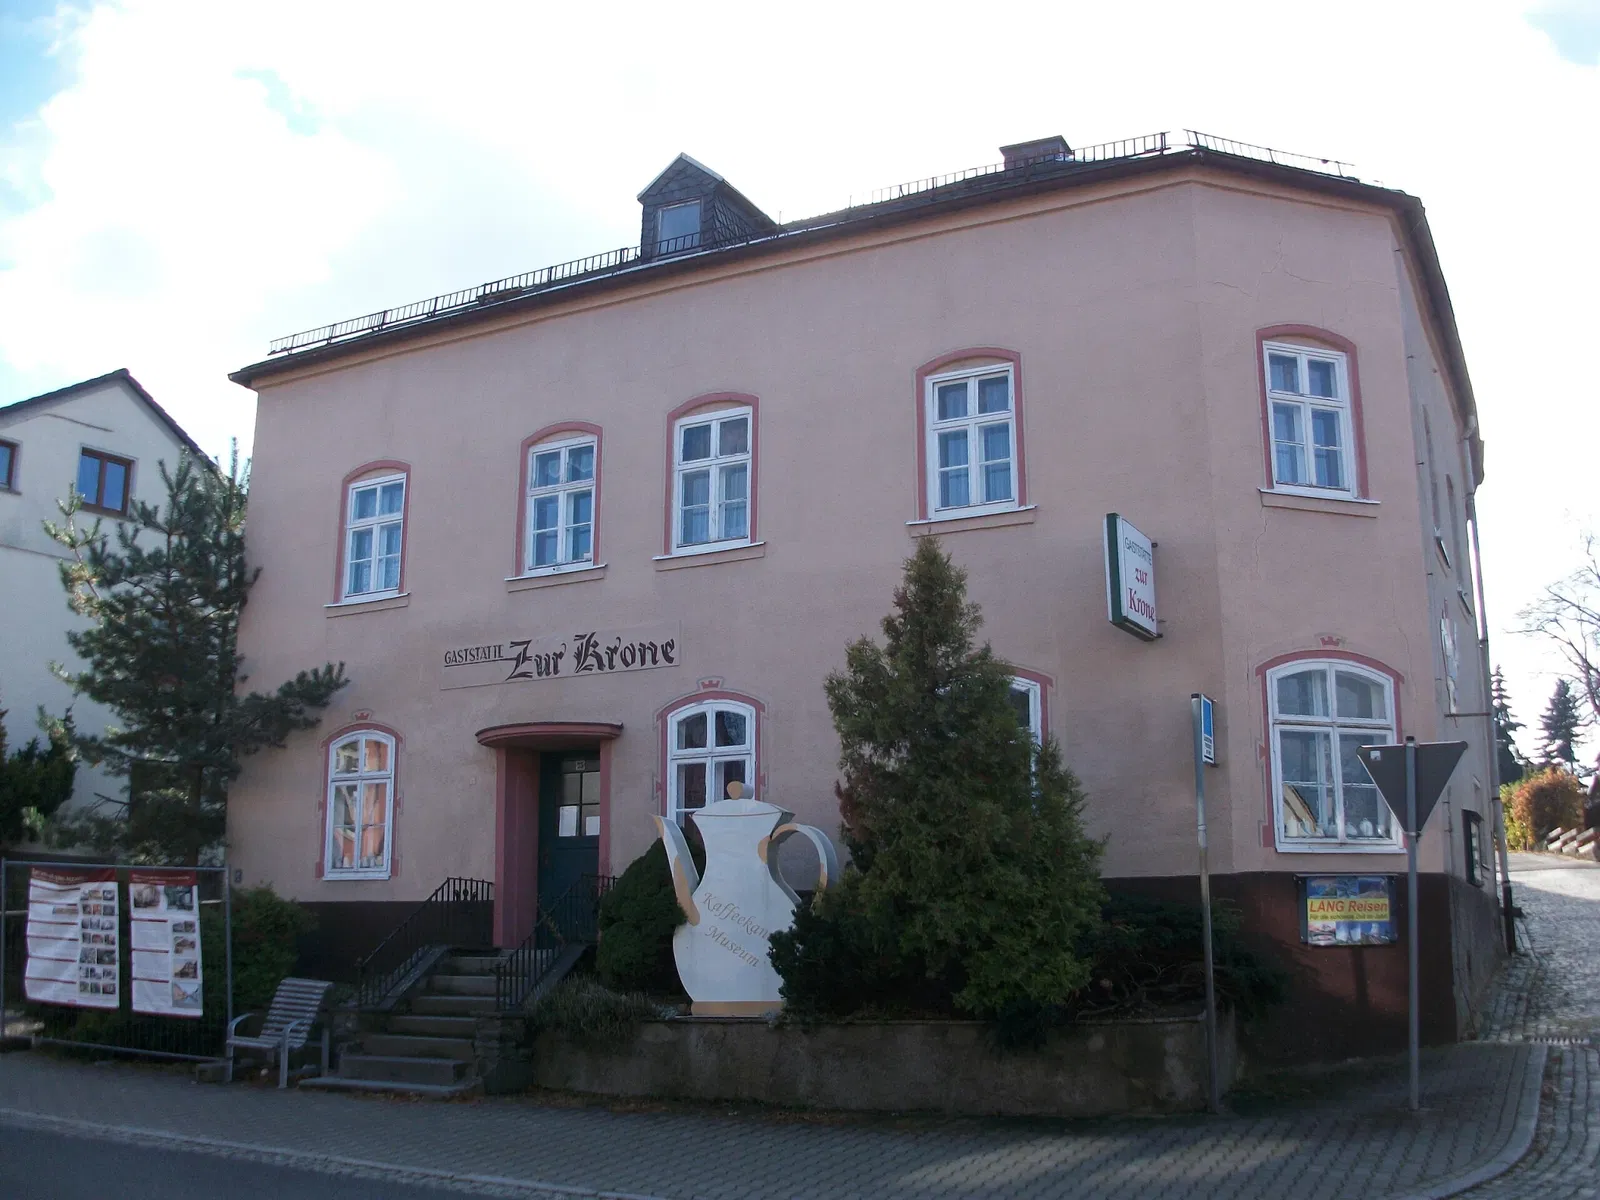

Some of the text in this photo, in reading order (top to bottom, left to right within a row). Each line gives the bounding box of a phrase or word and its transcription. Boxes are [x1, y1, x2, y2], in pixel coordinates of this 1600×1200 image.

[1135, 568, 1148, 586] zur
[1128, 587, 1155, 622] Krone
[505, 639, 566, 681] Zur
[574, 631, 675, 674] Krone
[702, 892, 771, 941] Kaffeekan
[1309, 900, 1388, 913] LANG Reisen
[704, 925, 760, 968] Museum
